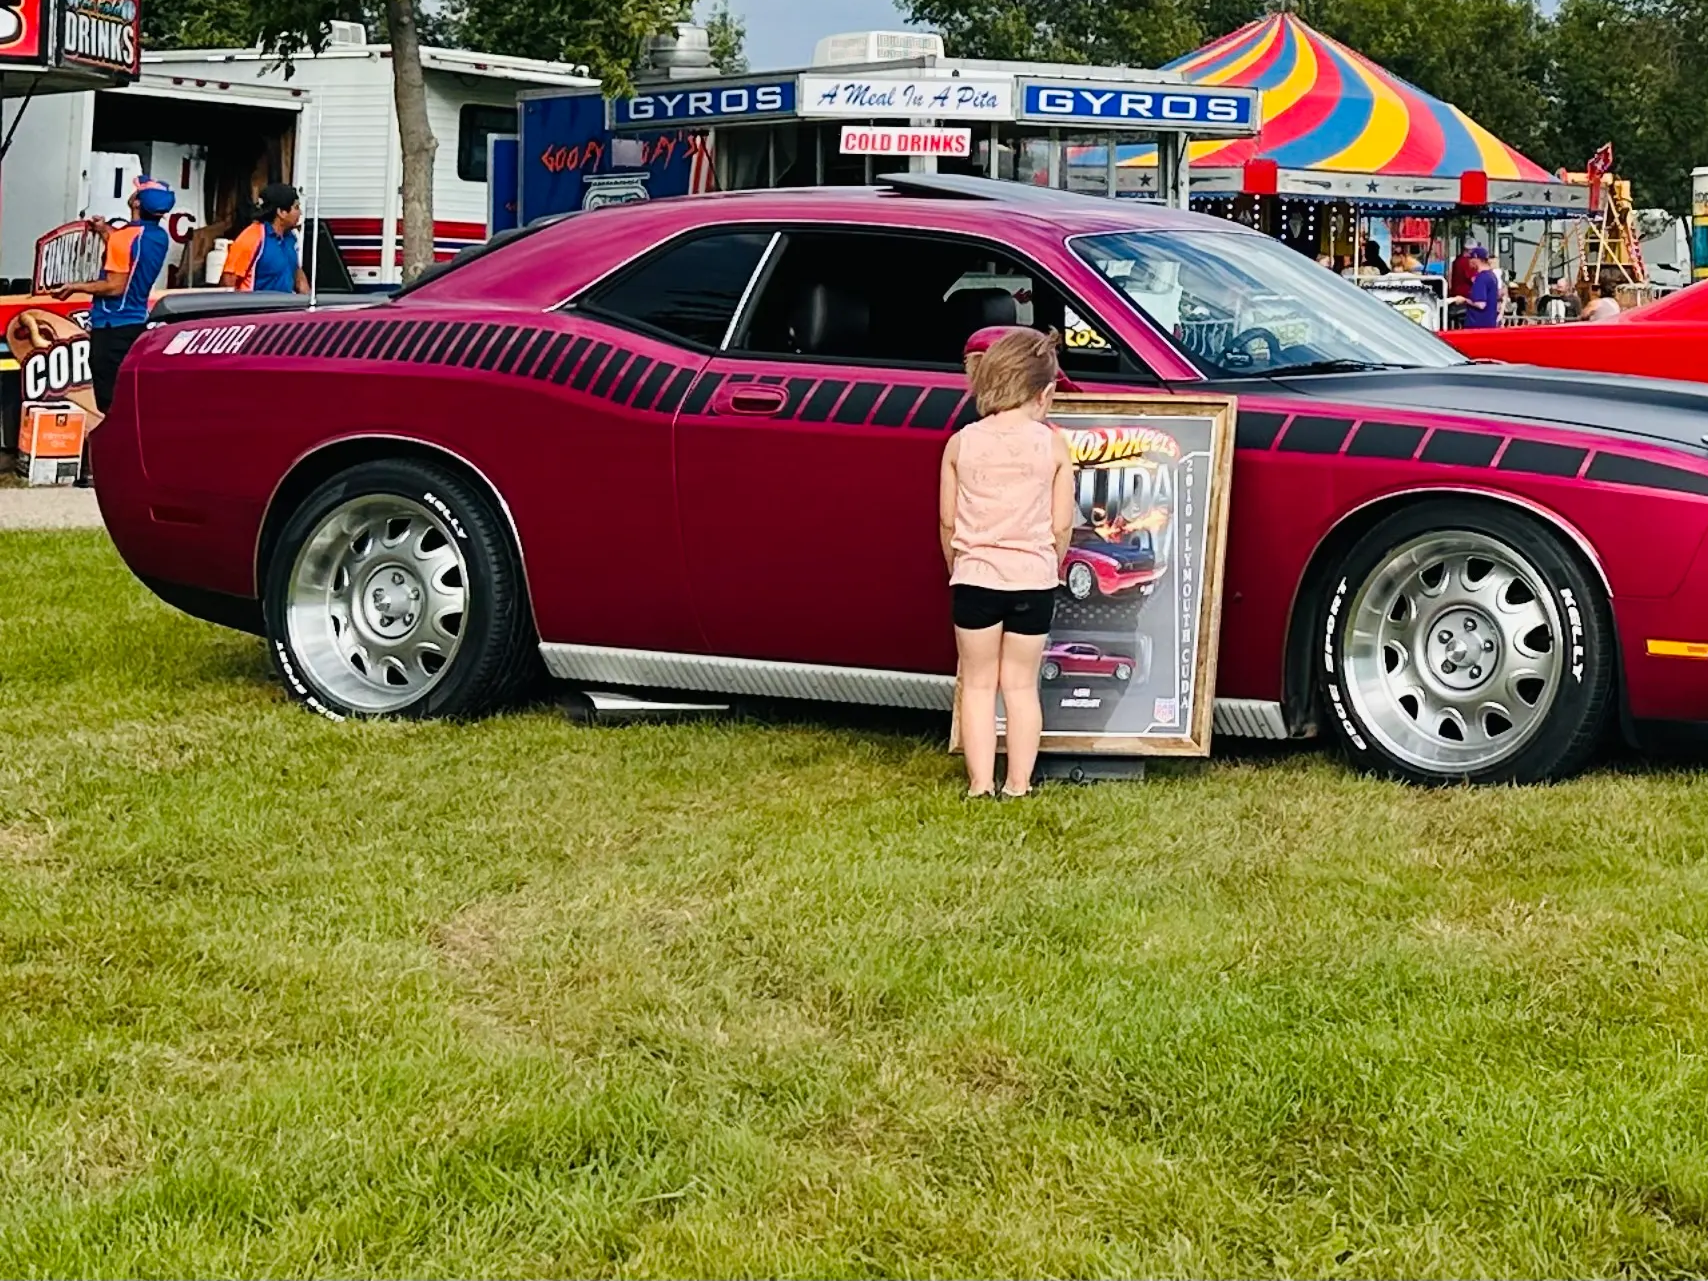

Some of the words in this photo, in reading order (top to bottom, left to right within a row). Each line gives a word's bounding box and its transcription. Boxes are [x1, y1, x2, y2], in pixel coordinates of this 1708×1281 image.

[65, 10, 134, 64] DRINKS
[629, 85, 782, 119] GYROS
[818, 84, 837, 107] A
[843, 84, 895, 106] Meal
[903, 84, 923, 107] In
[929, 86, 953, 109] A
[956, 86, 999, 110] Pita
[1039, 89, 1237, 121] GYROS
[845, 132, 890, 152] COLD
[898, 134, 967, 154] DRINKS
[184, 324, 256, 354] CUDA
[1074, 463, 1174, 523] UDA
[1185, 459, 1194, 517] 2010
[1182, 523, 1193, 643] PLYMOUTH
[1560, 587, 1584, 684] KELLY
[1180, 648, 1191, 709] CUDA
